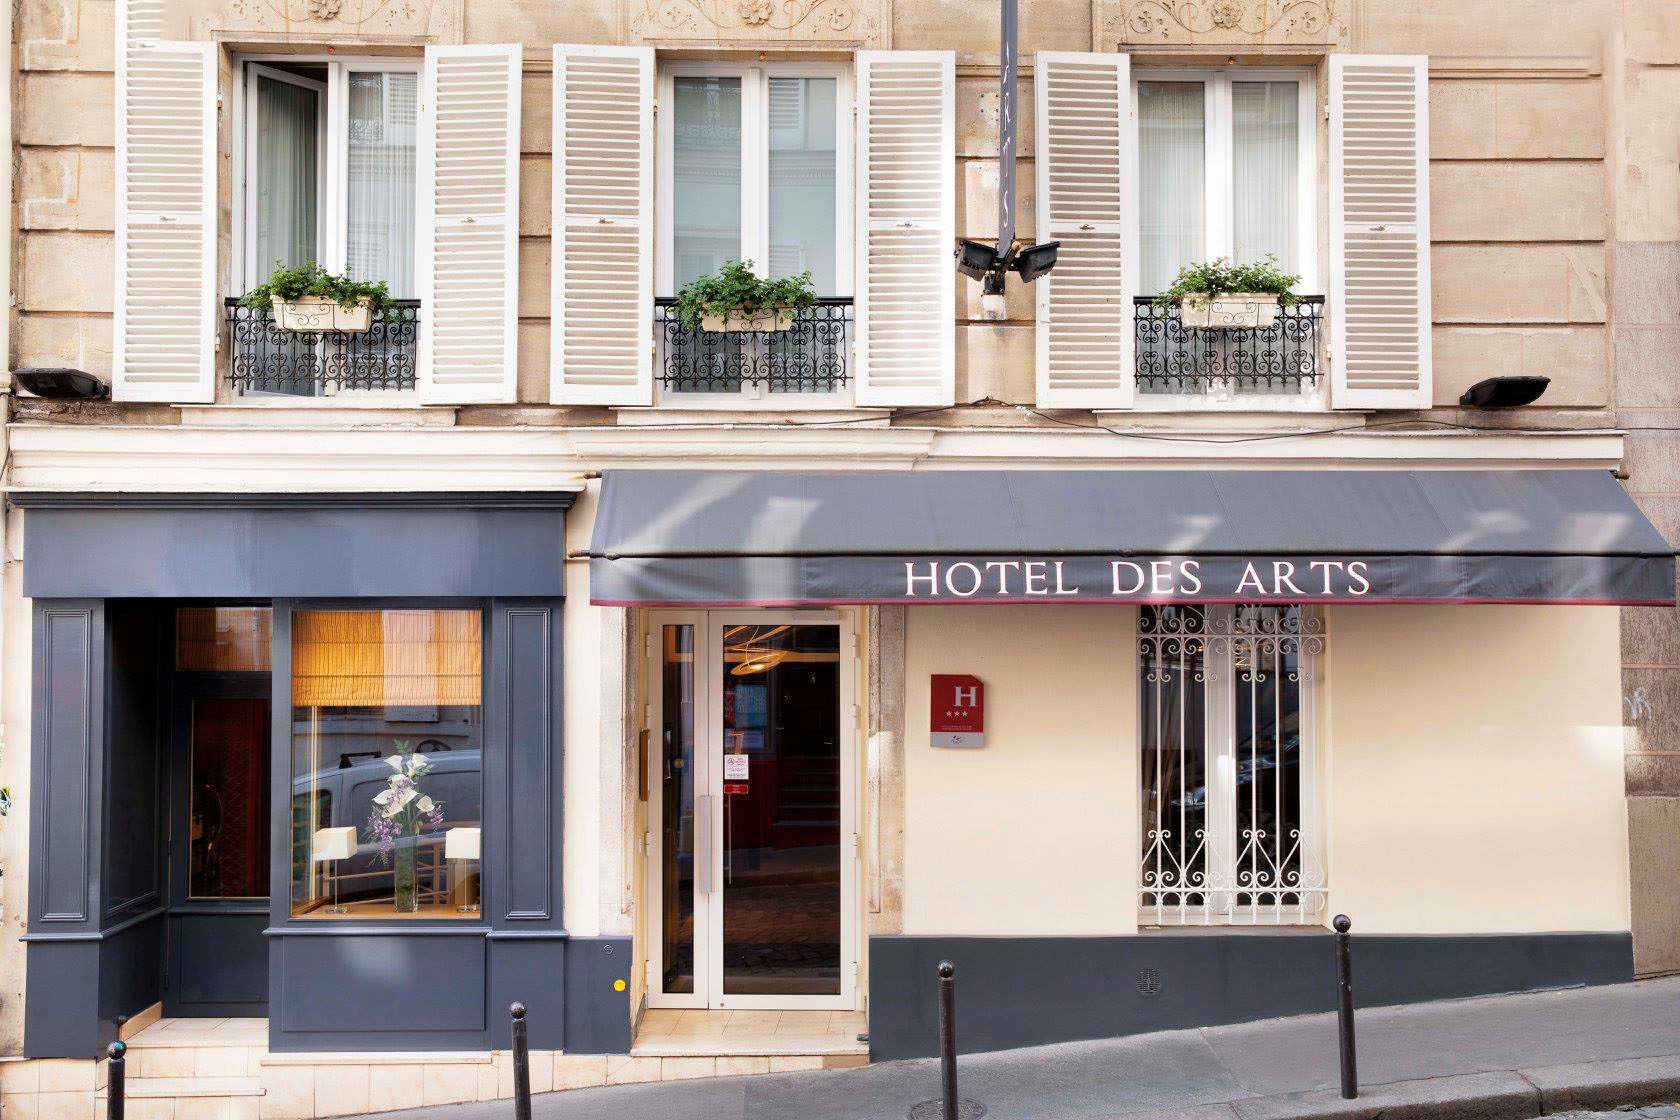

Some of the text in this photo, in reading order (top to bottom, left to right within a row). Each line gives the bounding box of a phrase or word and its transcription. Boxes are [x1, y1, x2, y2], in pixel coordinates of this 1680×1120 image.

[904, 560, 1371, 597] HOTEL DES ARTS
[953, 686, 979, 707] H
